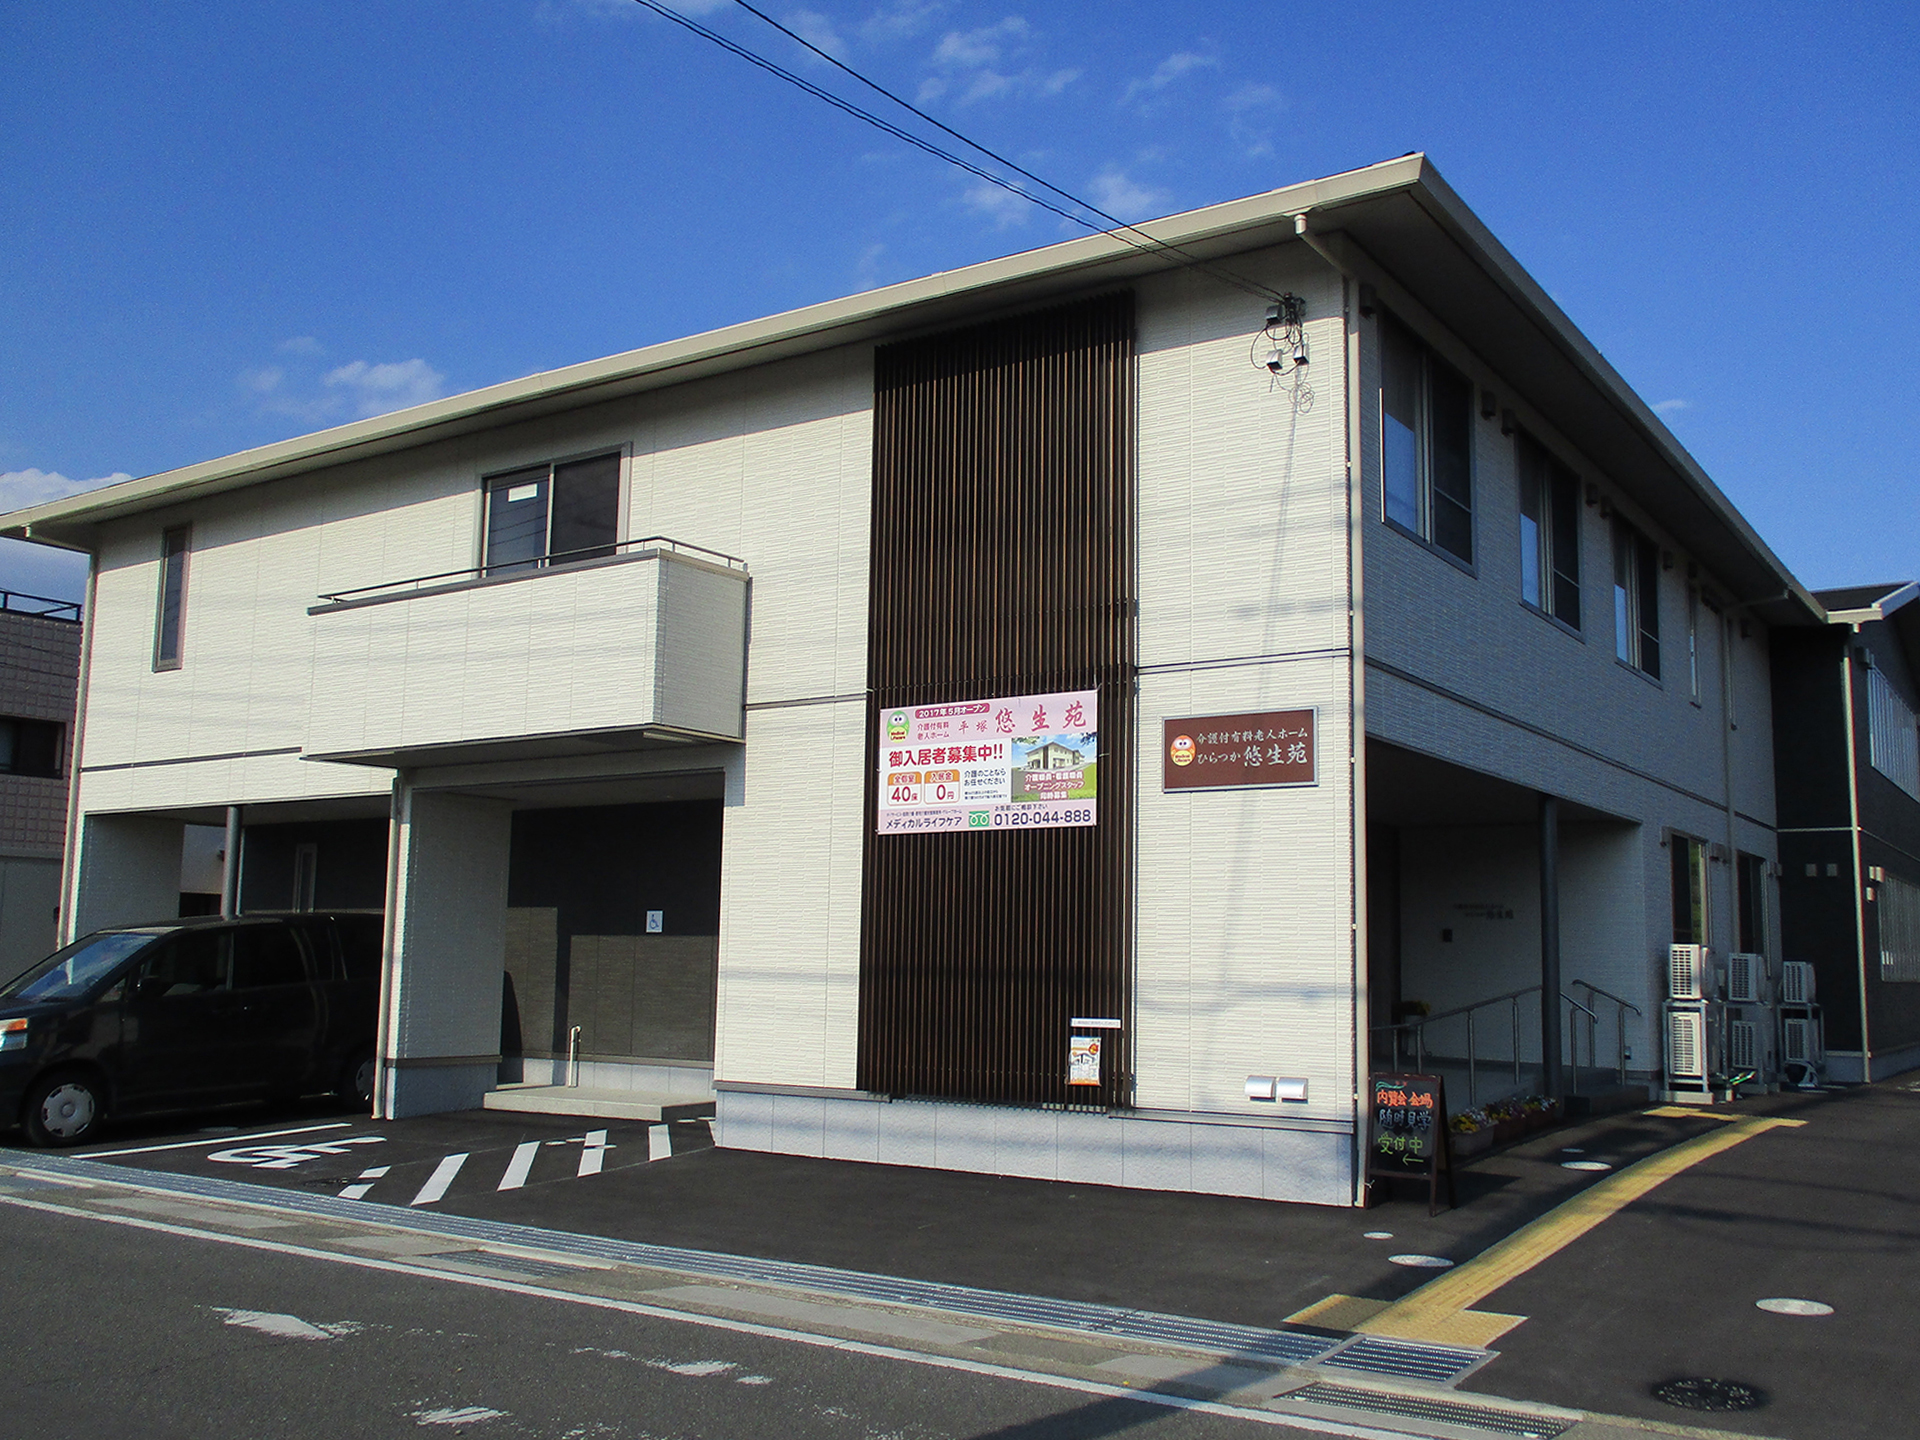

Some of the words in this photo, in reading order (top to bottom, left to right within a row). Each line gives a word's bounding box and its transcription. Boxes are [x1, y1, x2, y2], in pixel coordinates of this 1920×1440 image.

[918, 704, 987, 718] 2017年5月オープン
[958, 720, 989, 735] 平塚
[995, 700, 1087, 734] 悠生苑
[917, 721, 950, 731] 介護付有料
[917, 731, 950, 740] 老人ホーム
[1196, 727, 1308, 745] 介護付有料老人ホーム
[888, 743, 1003, 768] 御入居者募集中!!
[1197, 751, 1241, 765] ひらつか
[1243, 742, 1308, 767] 悠生苑
[963, 768, 1006, 778] 介護のことなら
[963, 777, 1006, 787] お任せください
[1024, 781, 1085, 792] オープニングスタッフ
[936, 784, 955, 801] 0円
[886, 816, 962, 829] メディカルライフケア
[1379, 1108, 1432, 1131] 随時見学
[1378, 1131, 1423, 1155] 受付中
